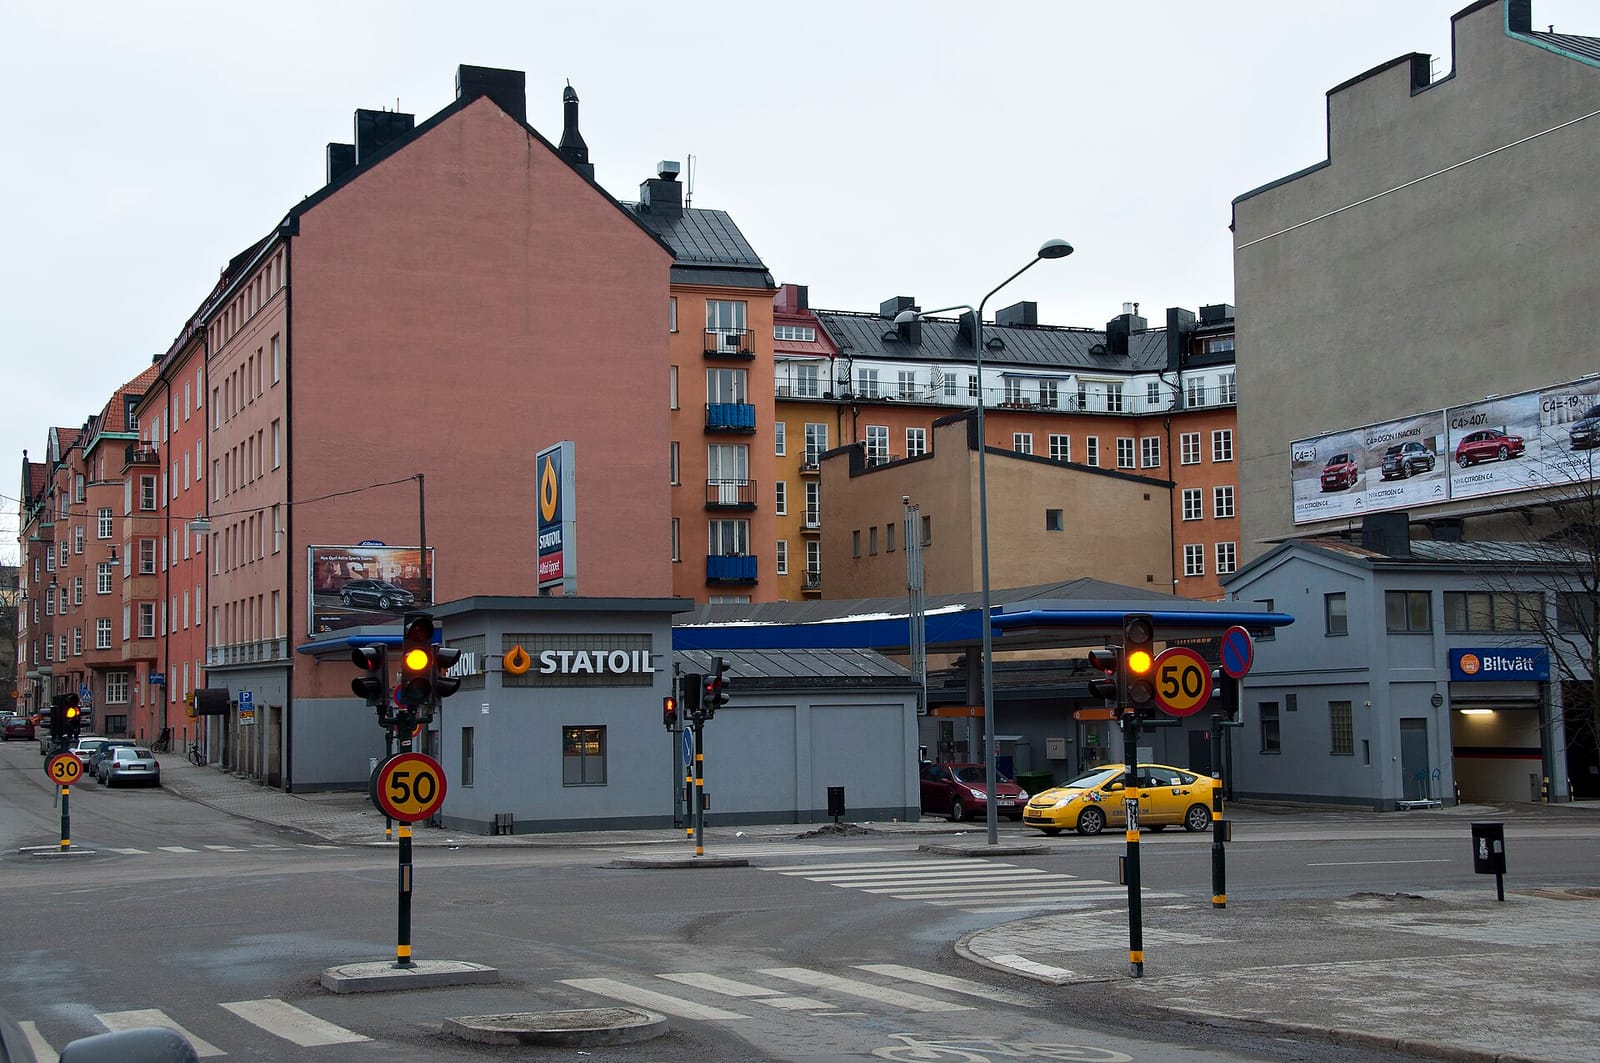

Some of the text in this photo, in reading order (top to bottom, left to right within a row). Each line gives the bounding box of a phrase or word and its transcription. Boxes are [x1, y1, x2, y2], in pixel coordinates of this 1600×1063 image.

[539, 530, 562, 550] STATOIL
[540, 650, 655, 674] STATOIL
[1483, 656, 1534, 672] Biltvätt
[1161, 664, 1203, 699] 50
[242, 692, 250, 702] P
[54, 760, 78, 778] 30
[391, 771, 436, 804] 50
